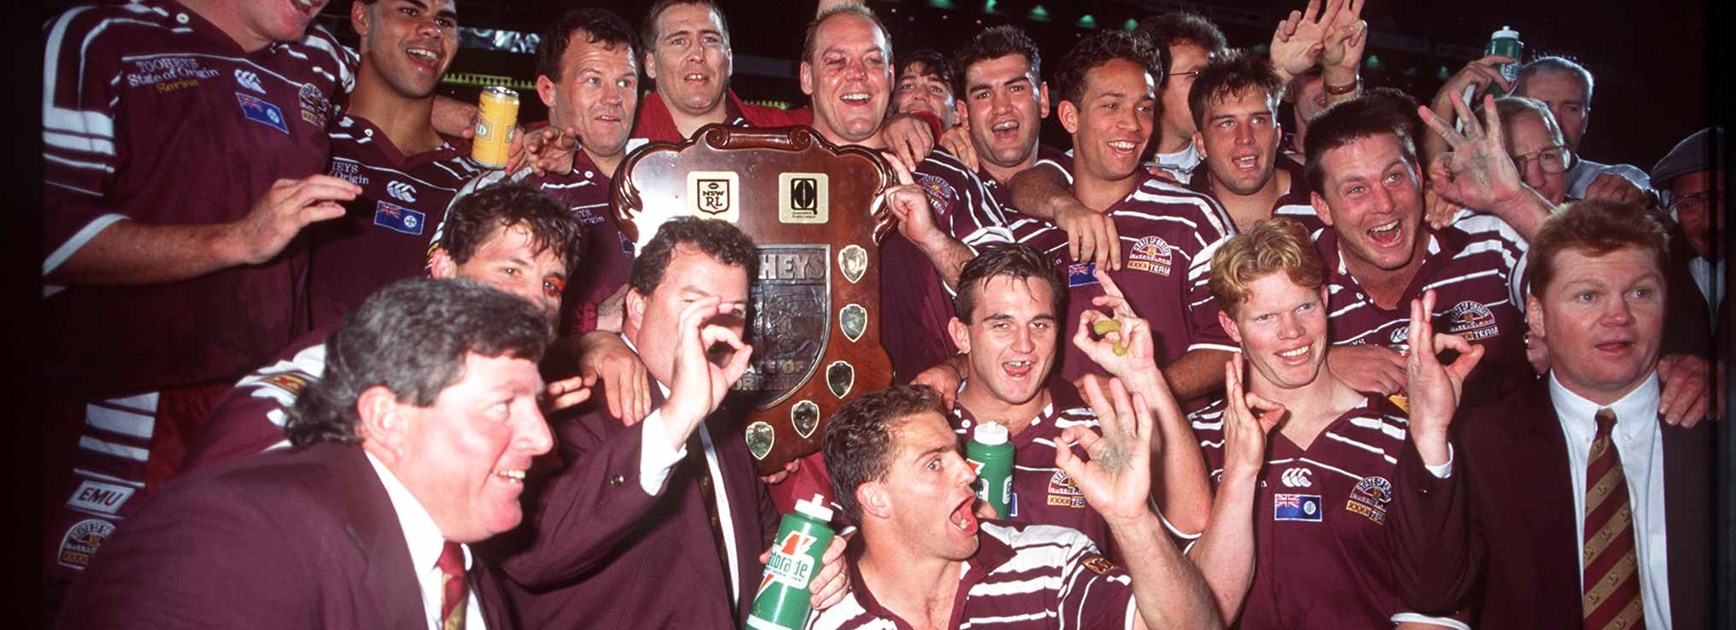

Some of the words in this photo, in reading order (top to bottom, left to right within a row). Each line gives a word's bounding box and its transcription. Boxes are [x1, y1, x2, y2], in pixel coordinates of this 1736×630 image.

[136, 58, 199, 72] TOOHEYS
[127, 73, 162, 87] State
[163, 67, 175, 80] of
[177, 67, 219, 79] Origin
[706, 196, 723, 209] RL
[758, 254, 826, 280] HEYS
[1150, 264, 1170, 275] TEAM
[1474, 327, 1498, 338] TEAM
[77, 487, 123, 506] EMU
